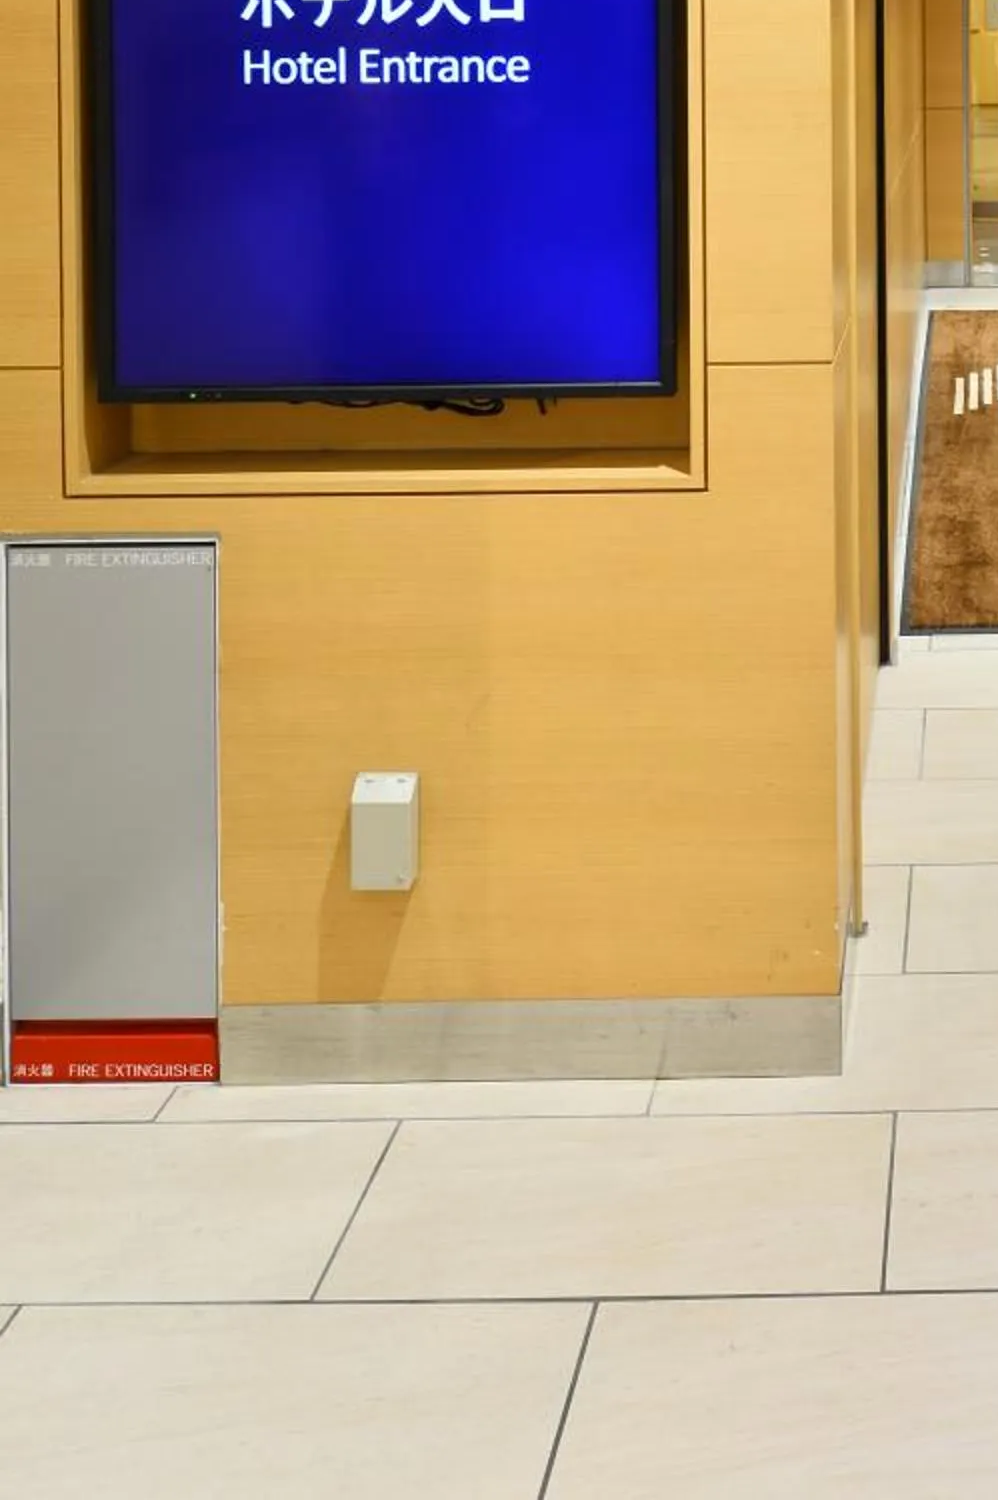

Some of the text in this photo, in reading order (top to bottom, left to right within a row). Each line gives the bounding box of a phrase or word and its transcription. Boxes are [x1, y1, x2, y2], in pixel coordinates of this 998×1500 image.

[242, 47, 531, 84] Hotel Entrance
[65, 552, 212, 567] FIRE EXTINGUISHER
[13, 1063, 54, 1077] 消火器
[69, 1063, 214, 1077] FIRE EXTINGUISHER
